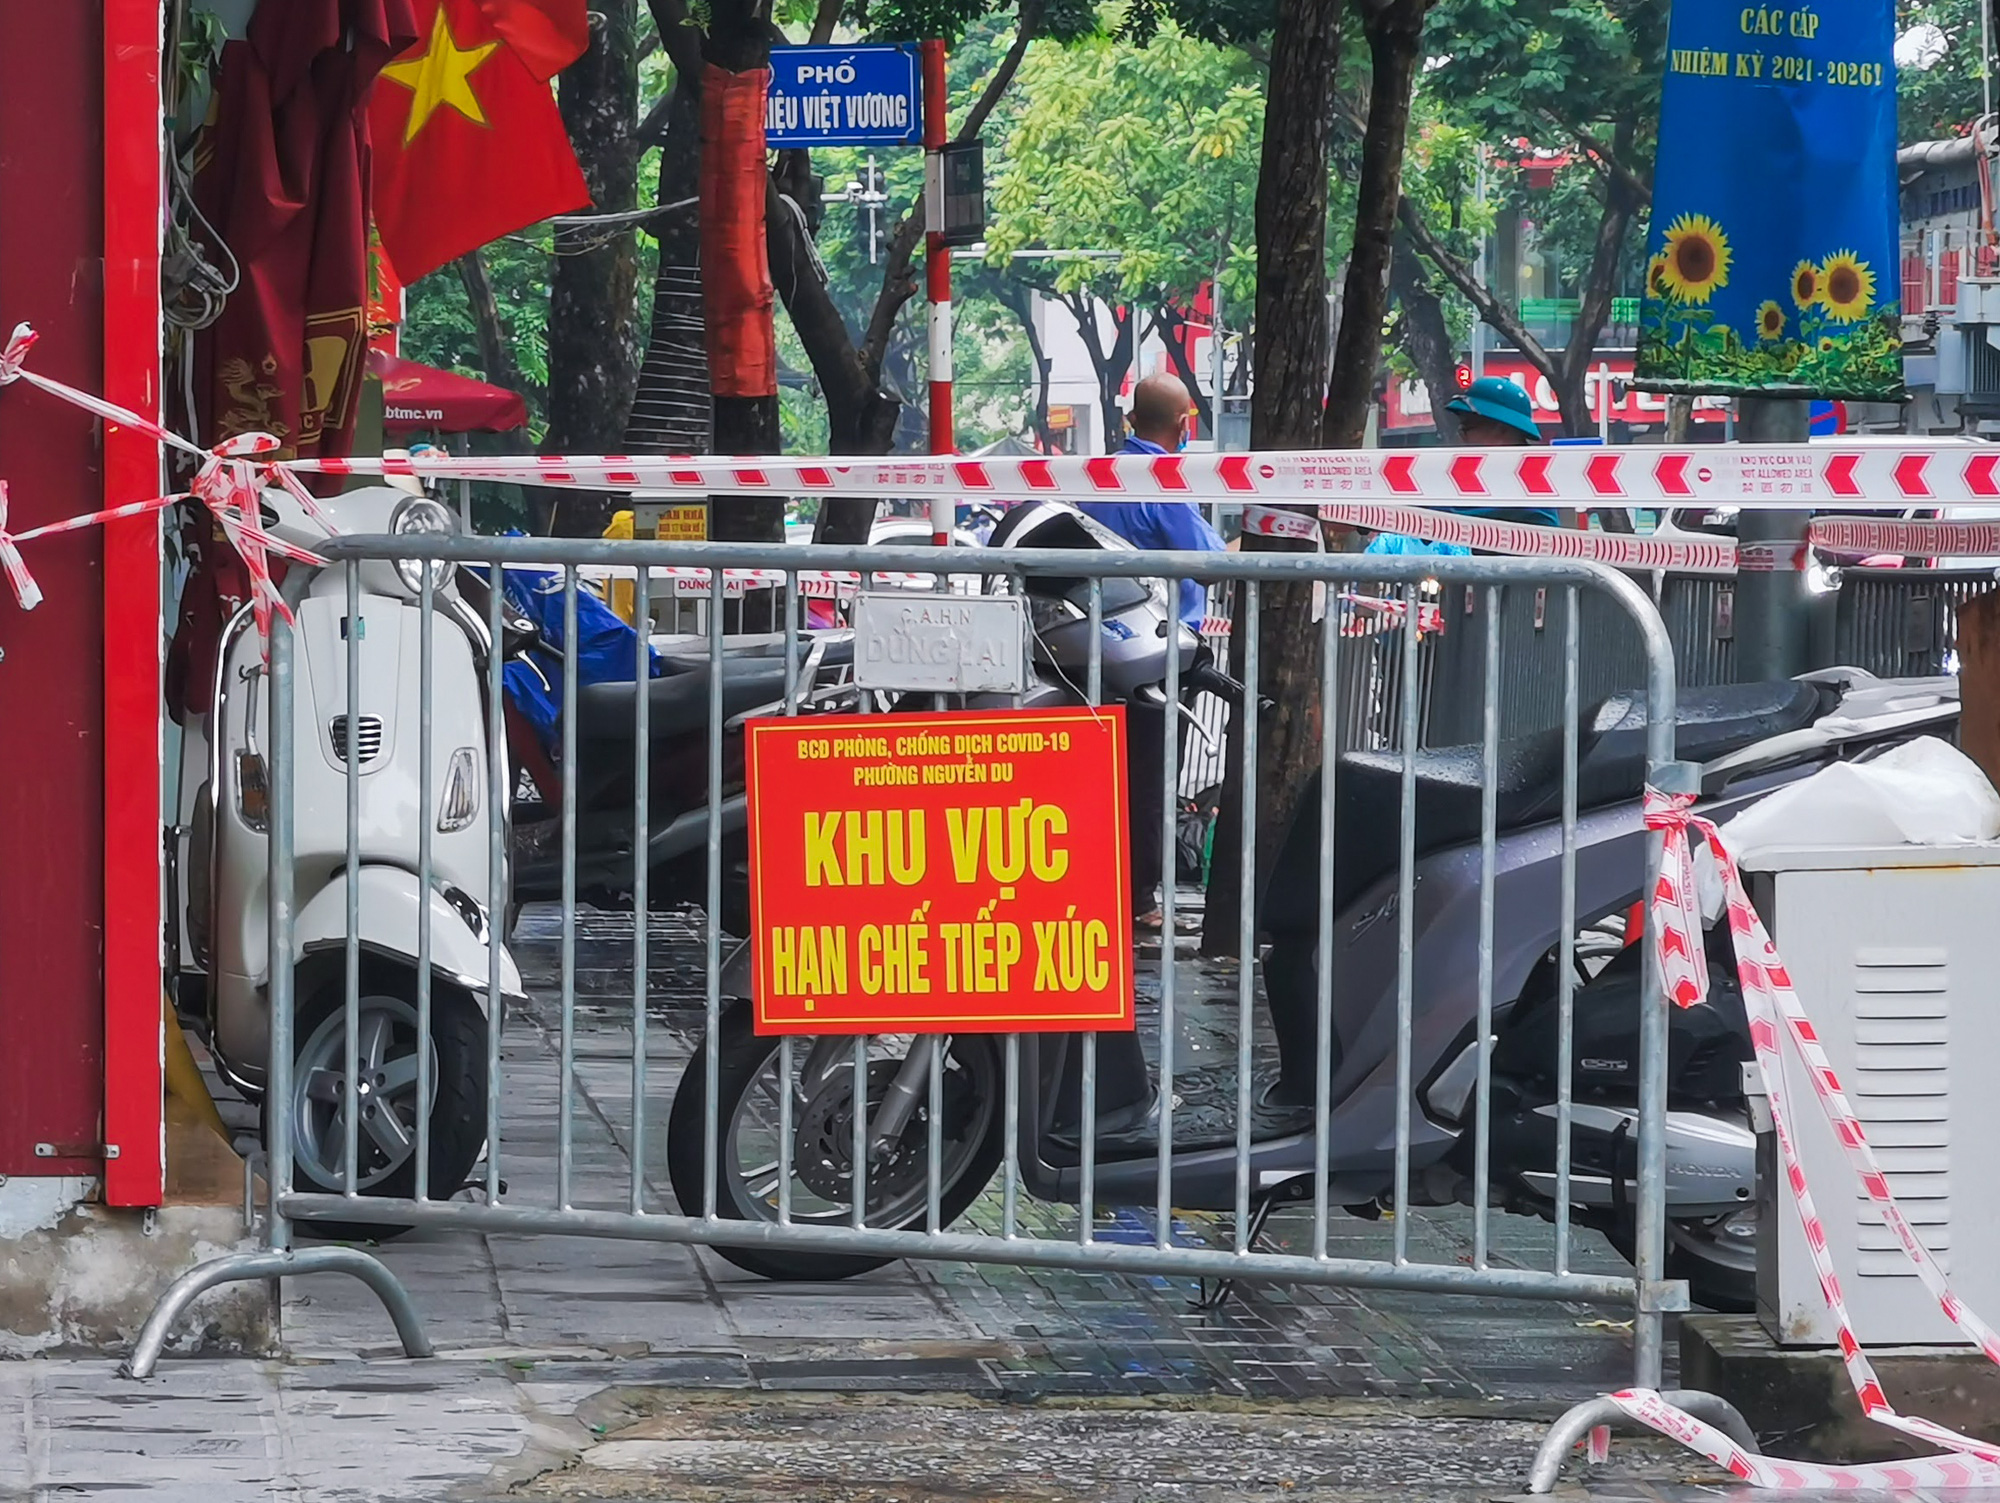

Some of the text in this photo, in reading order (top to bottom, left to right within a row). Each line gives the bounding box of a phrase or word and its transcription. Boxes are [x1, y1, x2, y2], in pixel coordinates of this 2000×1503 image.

[1740, 3, 1819, 39] CÁC CẤP
[797, 55, 856, 85] PHỐ
[1670, 46, 1729, 79] NHIỆM
[1735, 49, 1765, 78] KỲ
[764, 88, 908, 136] IỆU VIỆT VƯƠNG
[833, 734, 893, 758] PHÒNG,
[896, 730, 950, 756] CHỐNG
[954, 734, 993, 758] DỊCH
[996, 731, 1071, 753] COVID-19
[853, 757, 1014, 786] PHƯỜNG NGUYỄN DU
[804, 797, 1069, 900] KHU VỰC
[772, 899, 1110, 1012] HẠN CHẾ TIẾP XÚC
